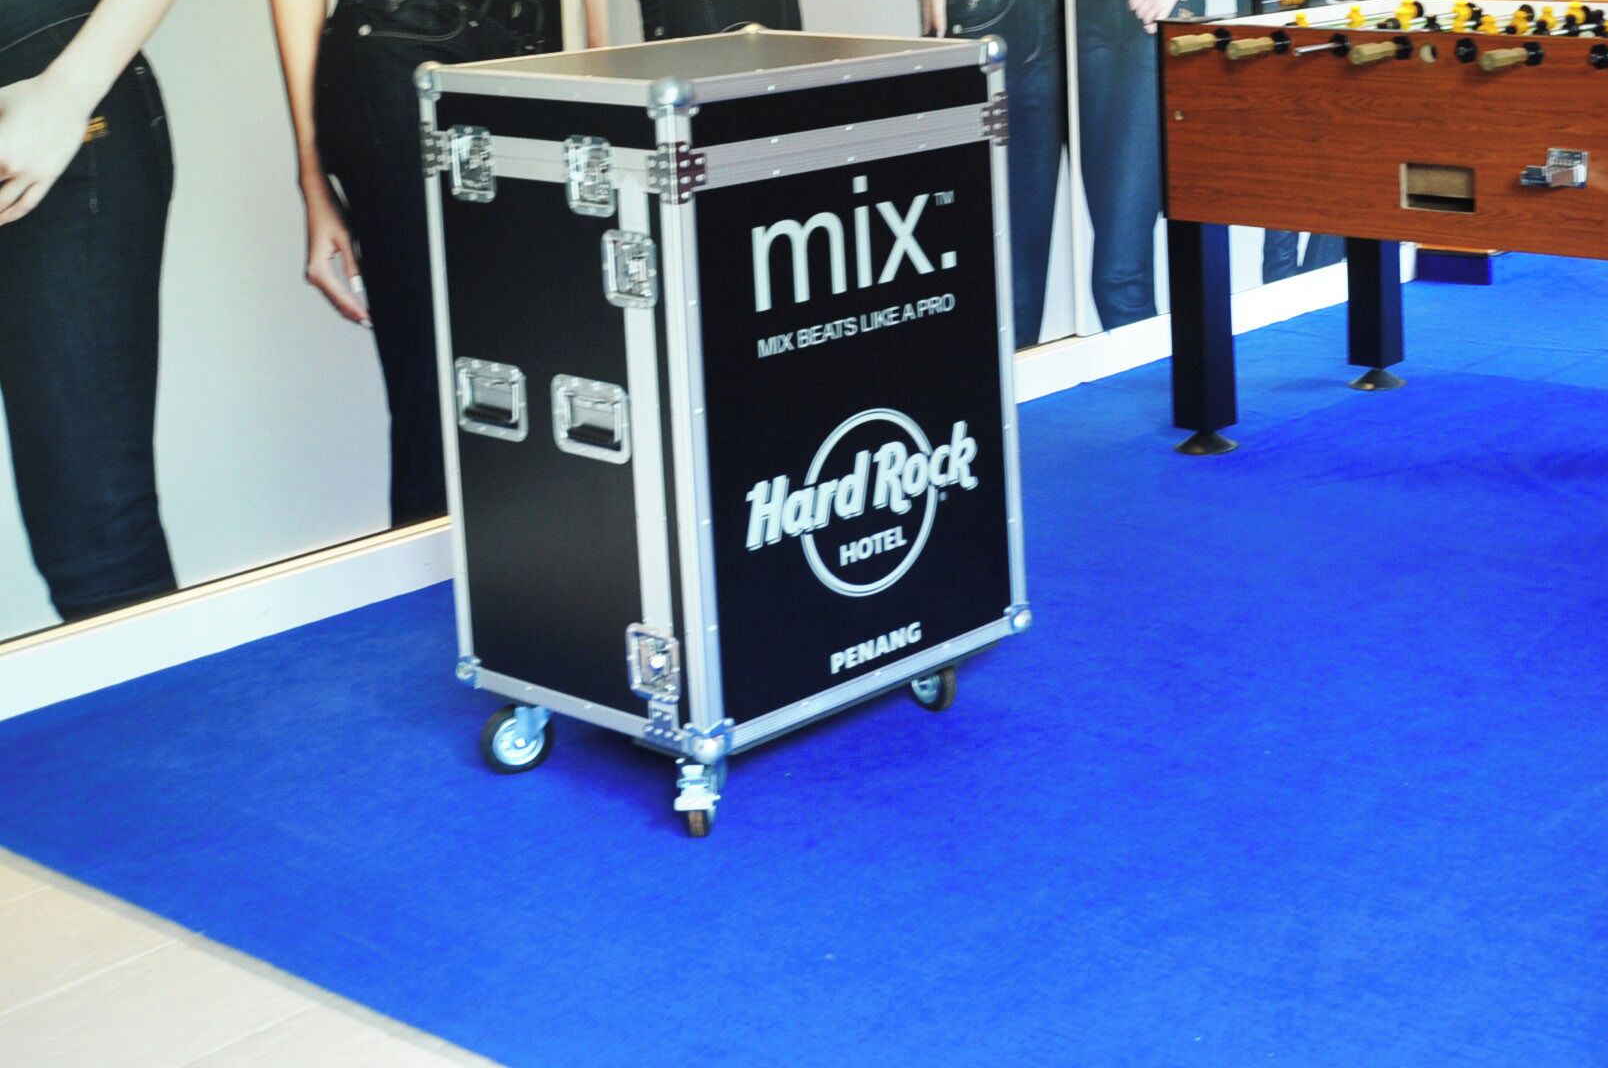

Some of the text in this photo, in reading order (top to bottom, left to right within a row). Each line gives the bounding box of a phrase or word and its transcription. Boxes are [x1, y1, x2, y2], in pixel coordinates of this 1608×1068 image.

[757, 293, 956, 358] MIX BEATS LIKE A PRO
[745, 420, 979, 552] Hard Rock
[839, 525, 908, 567] HOTEL
[830, 621, 922, 675] PENANG
